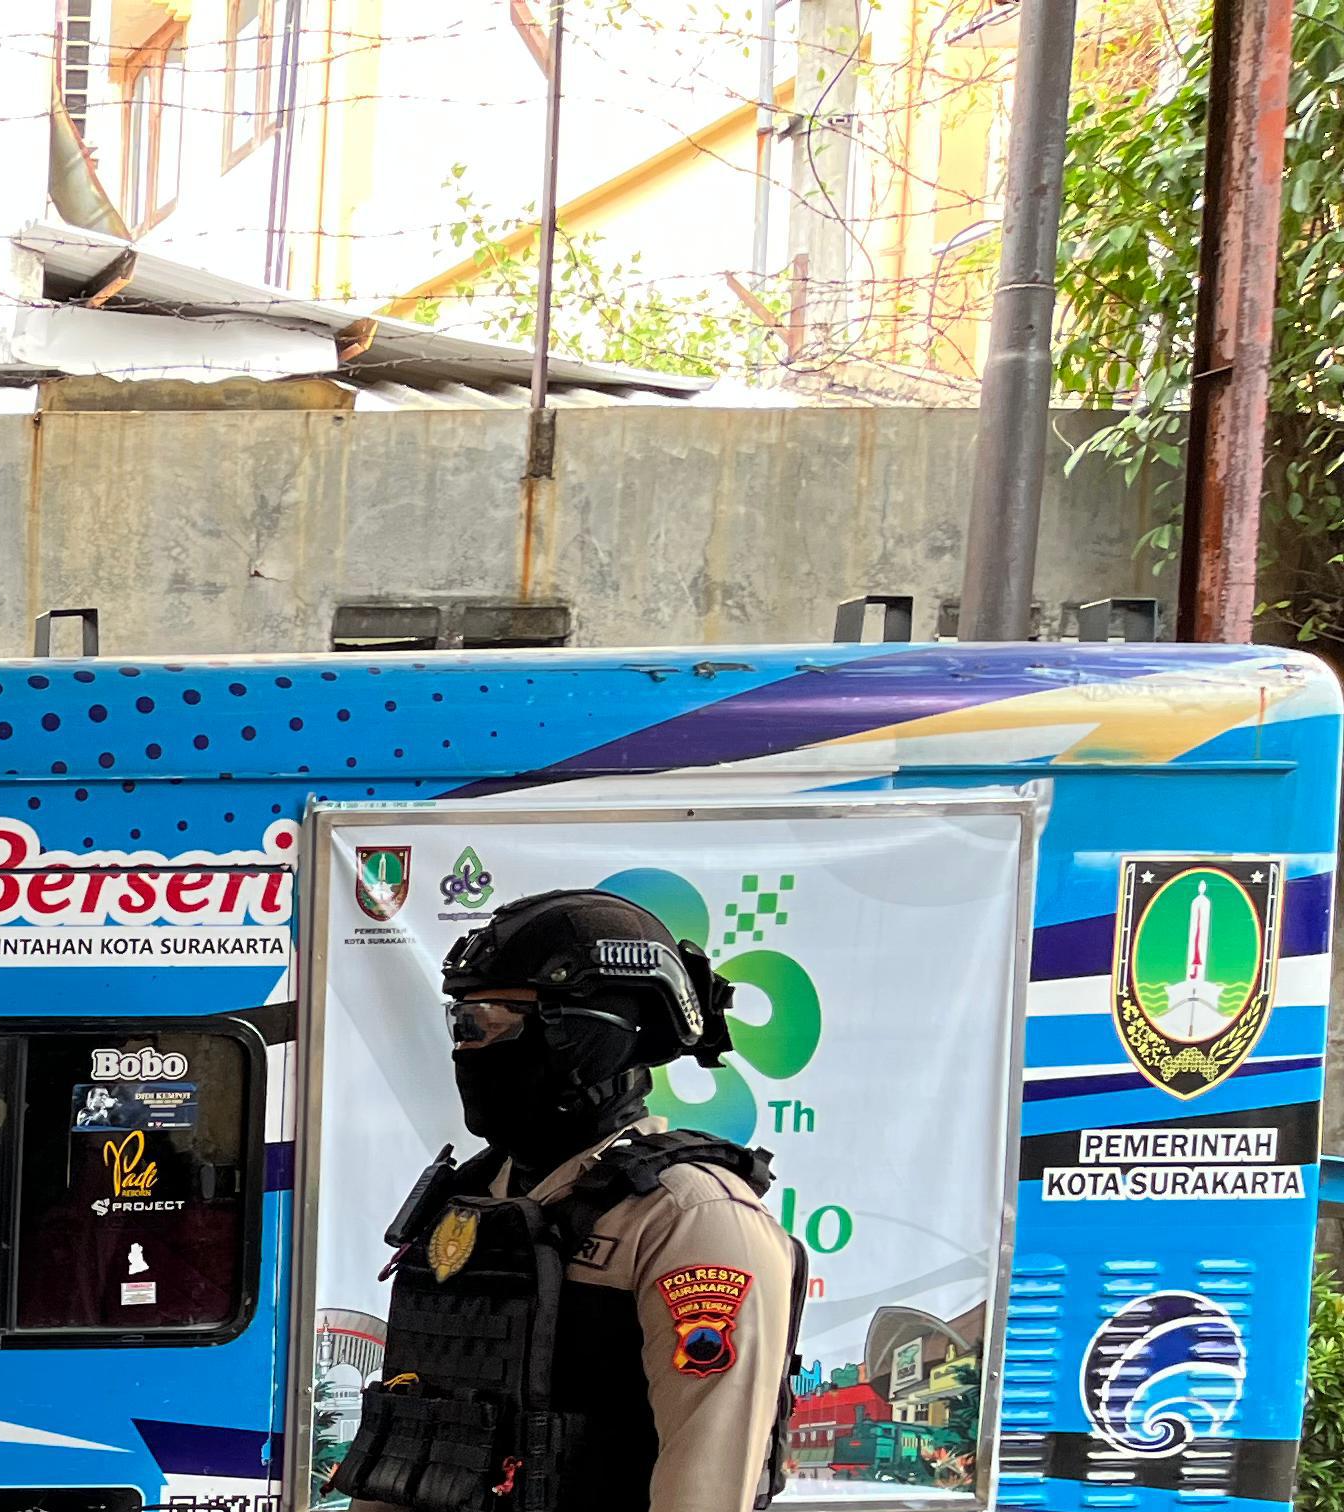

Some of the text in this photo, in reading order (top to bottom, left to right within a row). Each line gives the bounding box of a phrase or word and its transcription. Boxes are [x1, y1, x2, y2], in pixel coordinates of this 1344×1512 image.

[100, 938, 154, 955] KOTA
[162, 937, 285, 955] SURAKARTA
[93, 1049, 187, 1079] Bobo
[768, 1100, 815, 1133] Th
[1084, 1133, 1273, 1158] PEMERINTAH
[1047, 1171, 1300, 1197] KOTA SURAKARTA
[112, 1201, 185, 1212] PROJECT
[663, 1268, 745, 1290] POLRESTA
[668, 1283, 739, 1301] SURAKARTA
